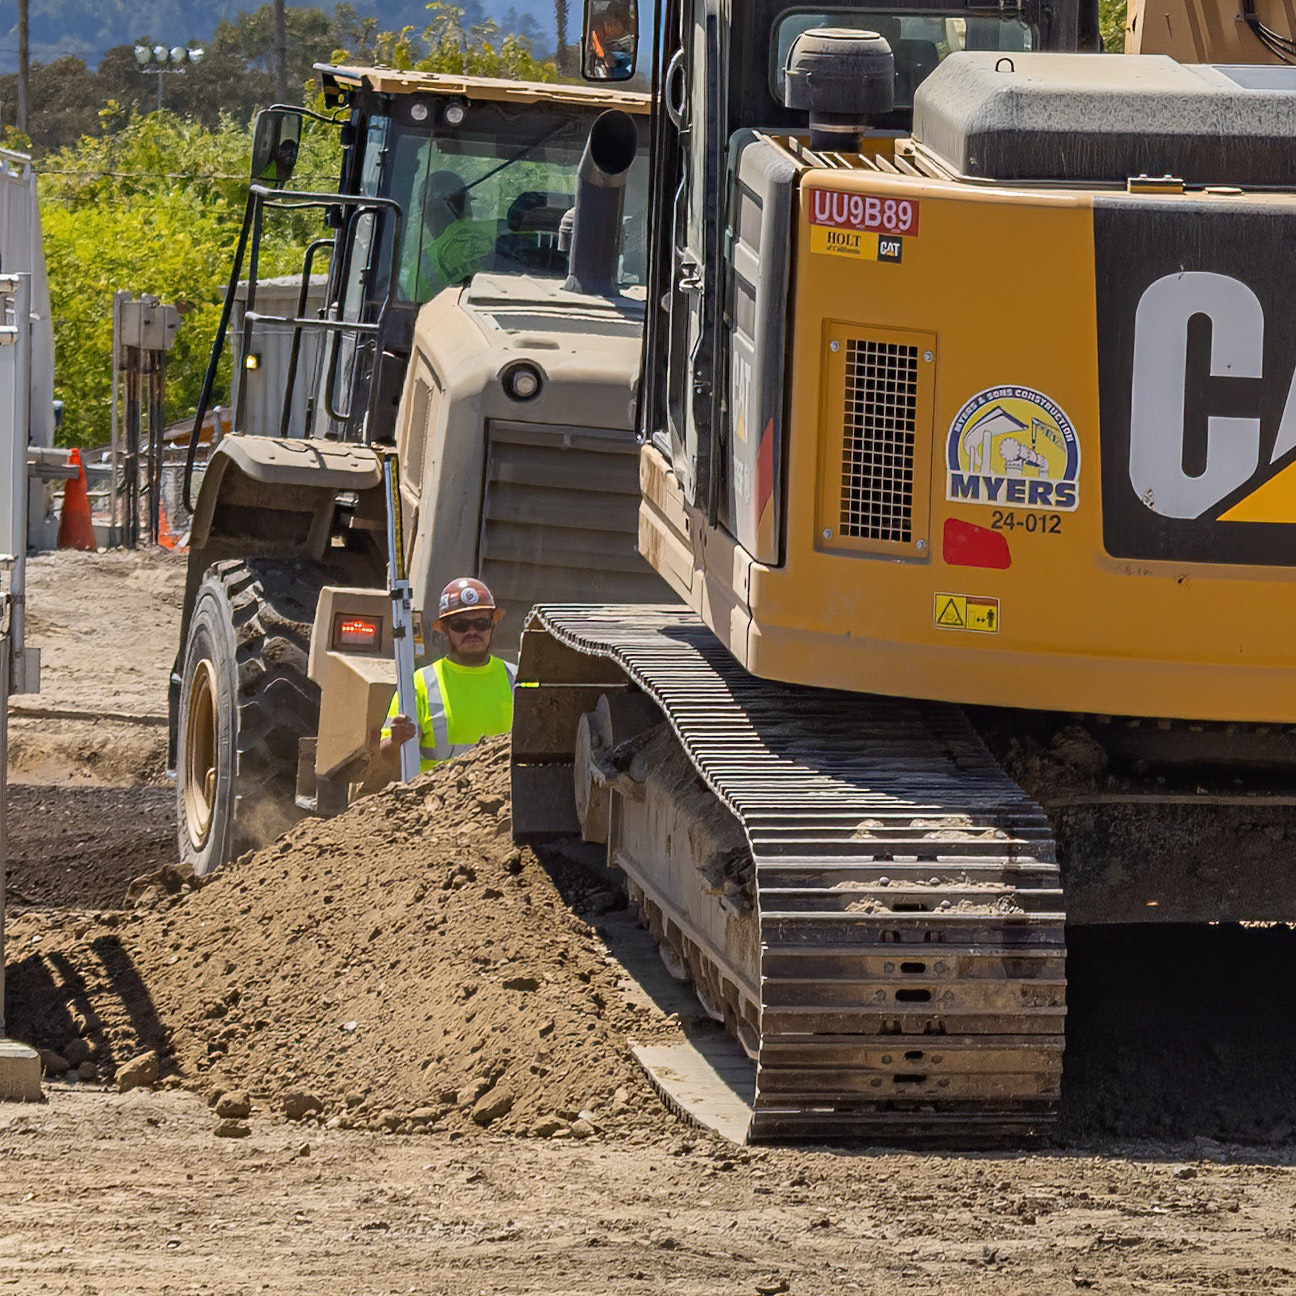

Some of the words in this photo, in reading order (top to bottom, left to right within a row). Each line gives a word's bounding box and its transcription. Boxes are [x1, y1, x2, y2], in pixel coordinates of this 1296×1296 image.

[815, 190, 912, 231] UU9B89
[827, 232, 861, 247] HOLT
[880, 241, 900, 256] CAT
[954, 401, 978, 432] MYERS
[986, 389, 1013, 400] SONS
[1015, 389, 1074, 442] CONSTRUCTION
[951, 473, 1077, 508] MYERS
[991, 510, 1062, 534] 24-012
